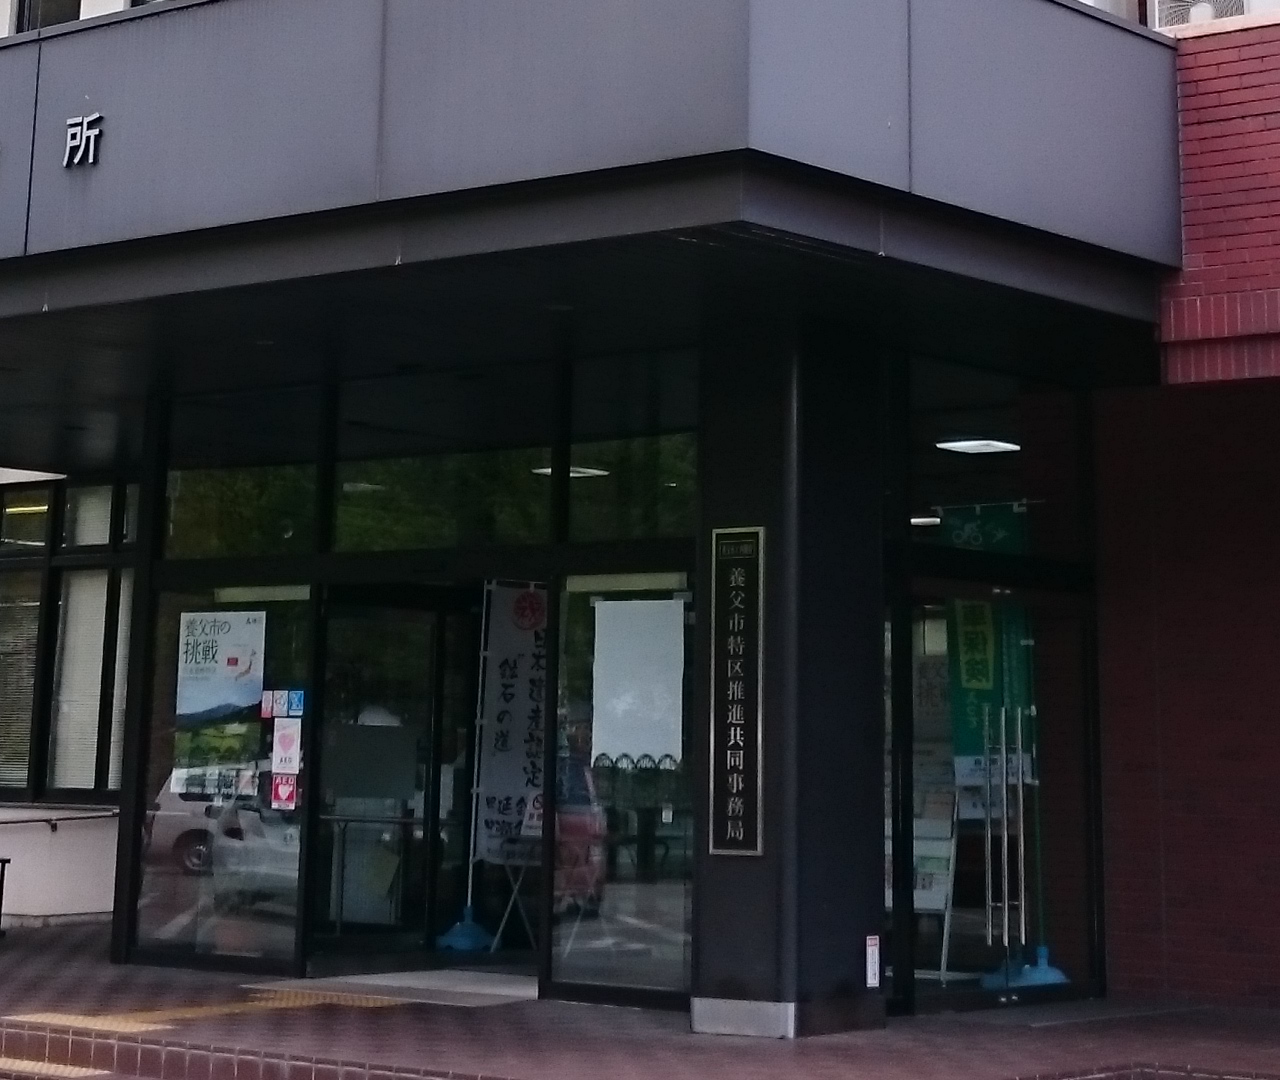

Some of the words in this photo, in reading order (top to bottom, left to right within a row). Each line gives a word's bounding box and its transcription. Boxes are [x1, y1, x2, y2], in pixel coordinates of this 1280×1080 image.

[185, 618, 231, 638] 養父市の
[183, 639, 218, 664] 挑戦
[727, 568, 746, 841] 養父市特区推進共同事務局
[275, 776, 295, 785] AED
